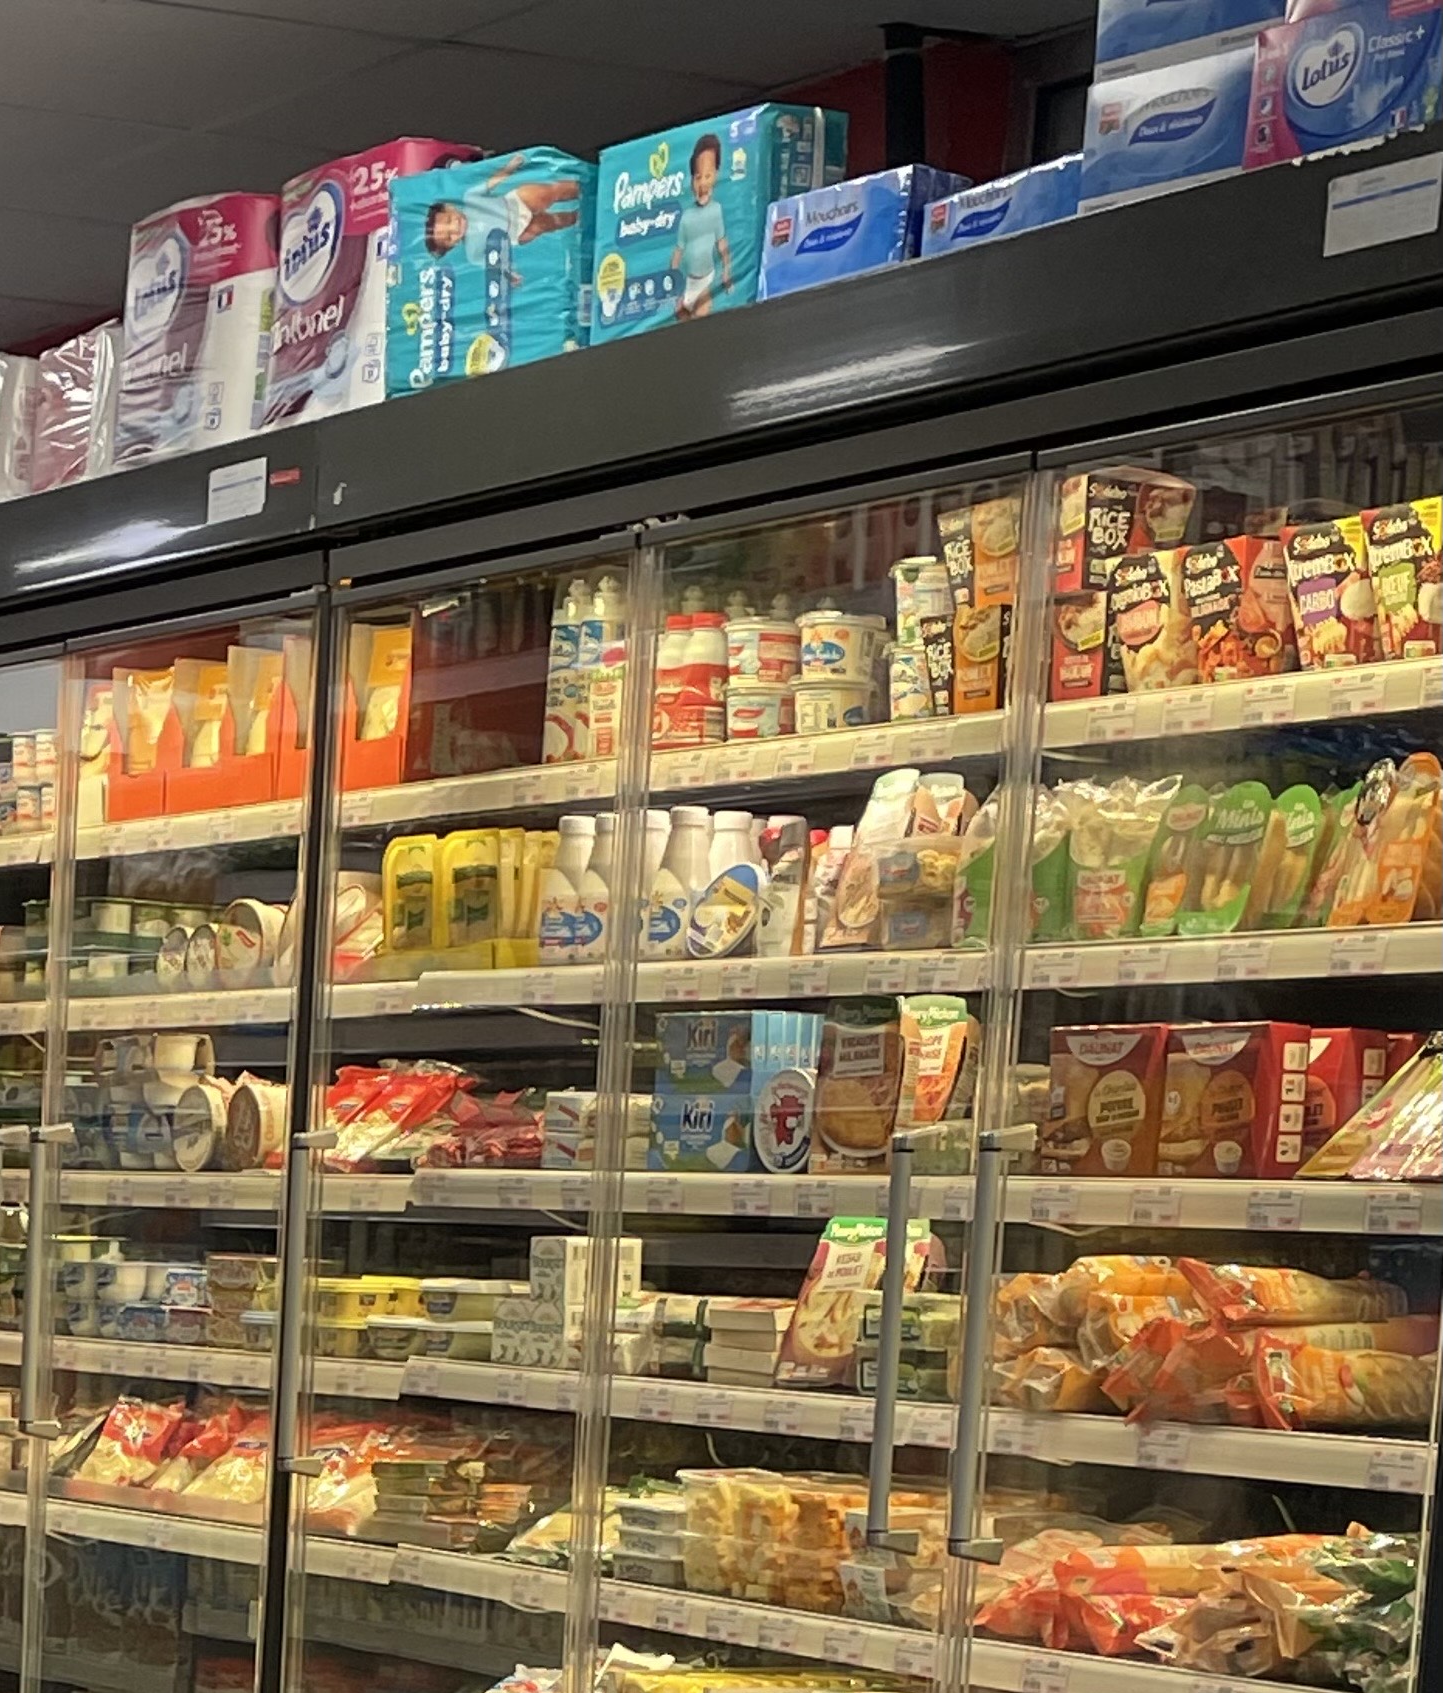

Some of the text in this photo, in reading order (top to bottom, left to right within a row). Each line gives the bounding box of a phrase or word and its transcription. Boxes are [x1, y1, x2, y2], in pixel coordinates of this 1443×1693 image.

[1301, 50, 1351, 91] Lotus
[613, 171, 684, 214] Pampers
[409, 265, 436, 391] Pampers
[436, 272, 452, 376] baby-dry
[1088, 506, 1131, 532] RICE
[1091, 526, 1128, 550] BOX
[685, 1018, 718, 1050] Kiri
[681, 1099, 715, 1133] Kiri
